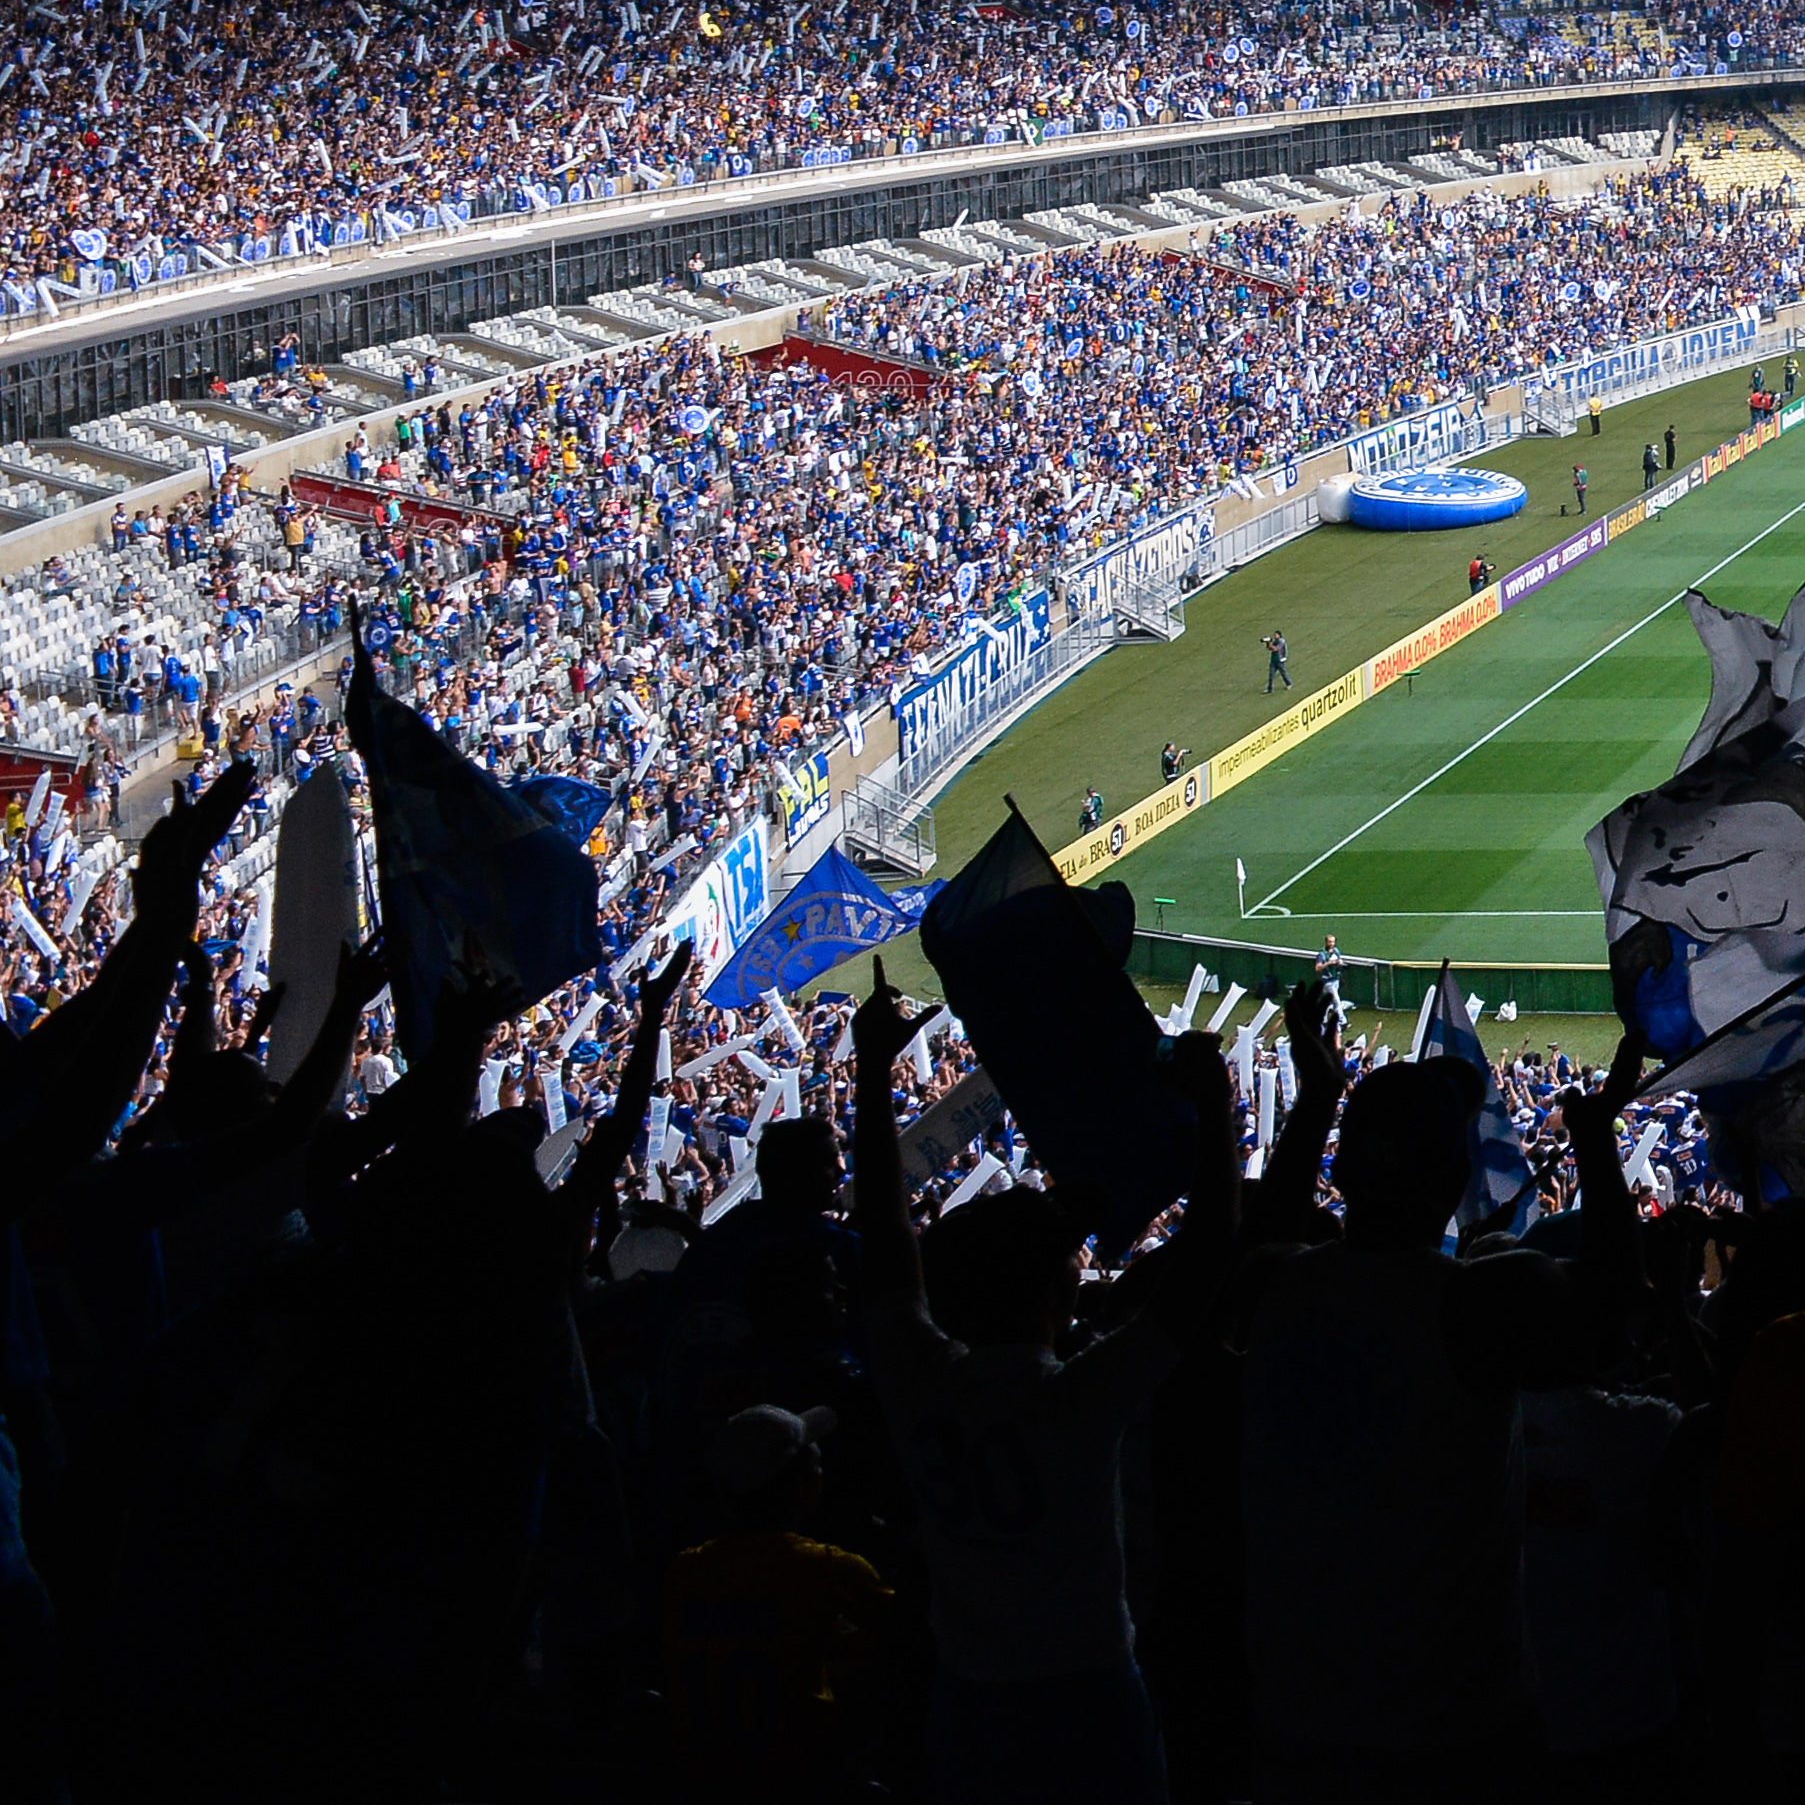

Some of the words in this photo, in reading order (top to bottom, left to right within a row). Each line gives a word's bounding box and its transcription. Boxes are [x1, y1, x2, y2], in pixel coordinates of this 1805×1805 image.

[1744, 428, 1758, 455] Itaú
[1761, 418, 1776, 444] Itaú
[1708, 450, 1723, 478] Itaú
[1726, 439, 1741, 466] Itaú
[1505, 574, 1525, 599] VIVO
[1525, 563, 1545, 588] TUDO
[1374, 646, 1414, 688] BRAHMA
[1413, 636, 1437, 663] 0,0%
[1439, 606, 1476, 648] BRAHMA
[1476, 593, 1497, 624] 0,0%
[1218, 714, 1299, 779] impermeabilizantes
[1301, 674, 1357, 731] quartzolit
[1185, 780, 1196, 803] 51
[1135, 811, 1153, 836] BOA
[1155, 793, 1181, 824] IDEIA
